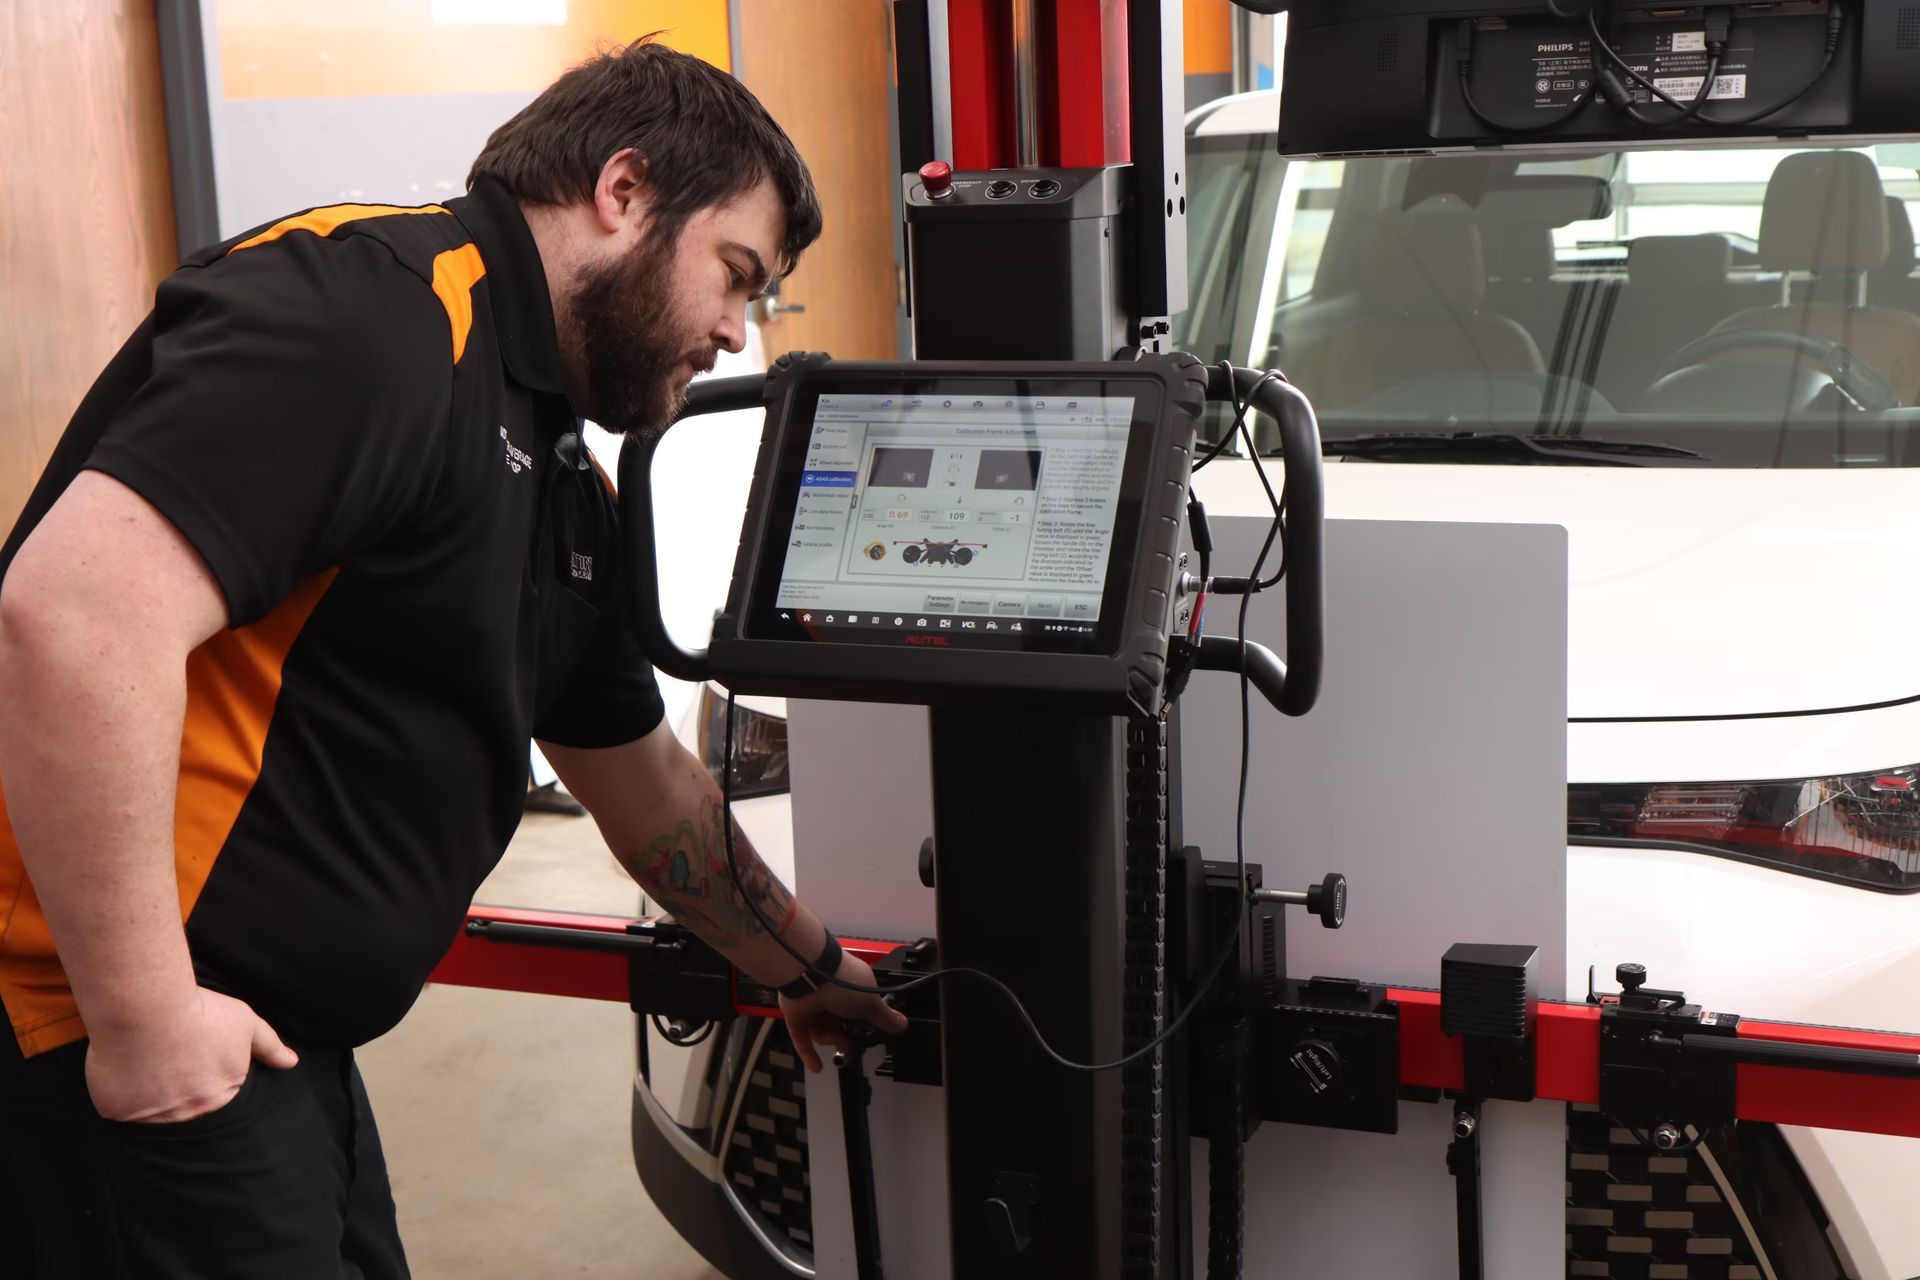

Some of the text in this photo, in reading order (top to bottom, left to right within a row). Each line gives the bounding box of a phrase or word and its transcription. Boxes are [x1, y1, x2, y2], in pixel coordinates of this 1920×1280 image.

[1537, 43, 1574, 52] PHILIPS
[888, 511, 909, 519] 0.69
[950, 512, 966, 520] 109
[903, 634, 951, 645] AUTEL
[1305, 1048, 1333, 1080] Left/Right
